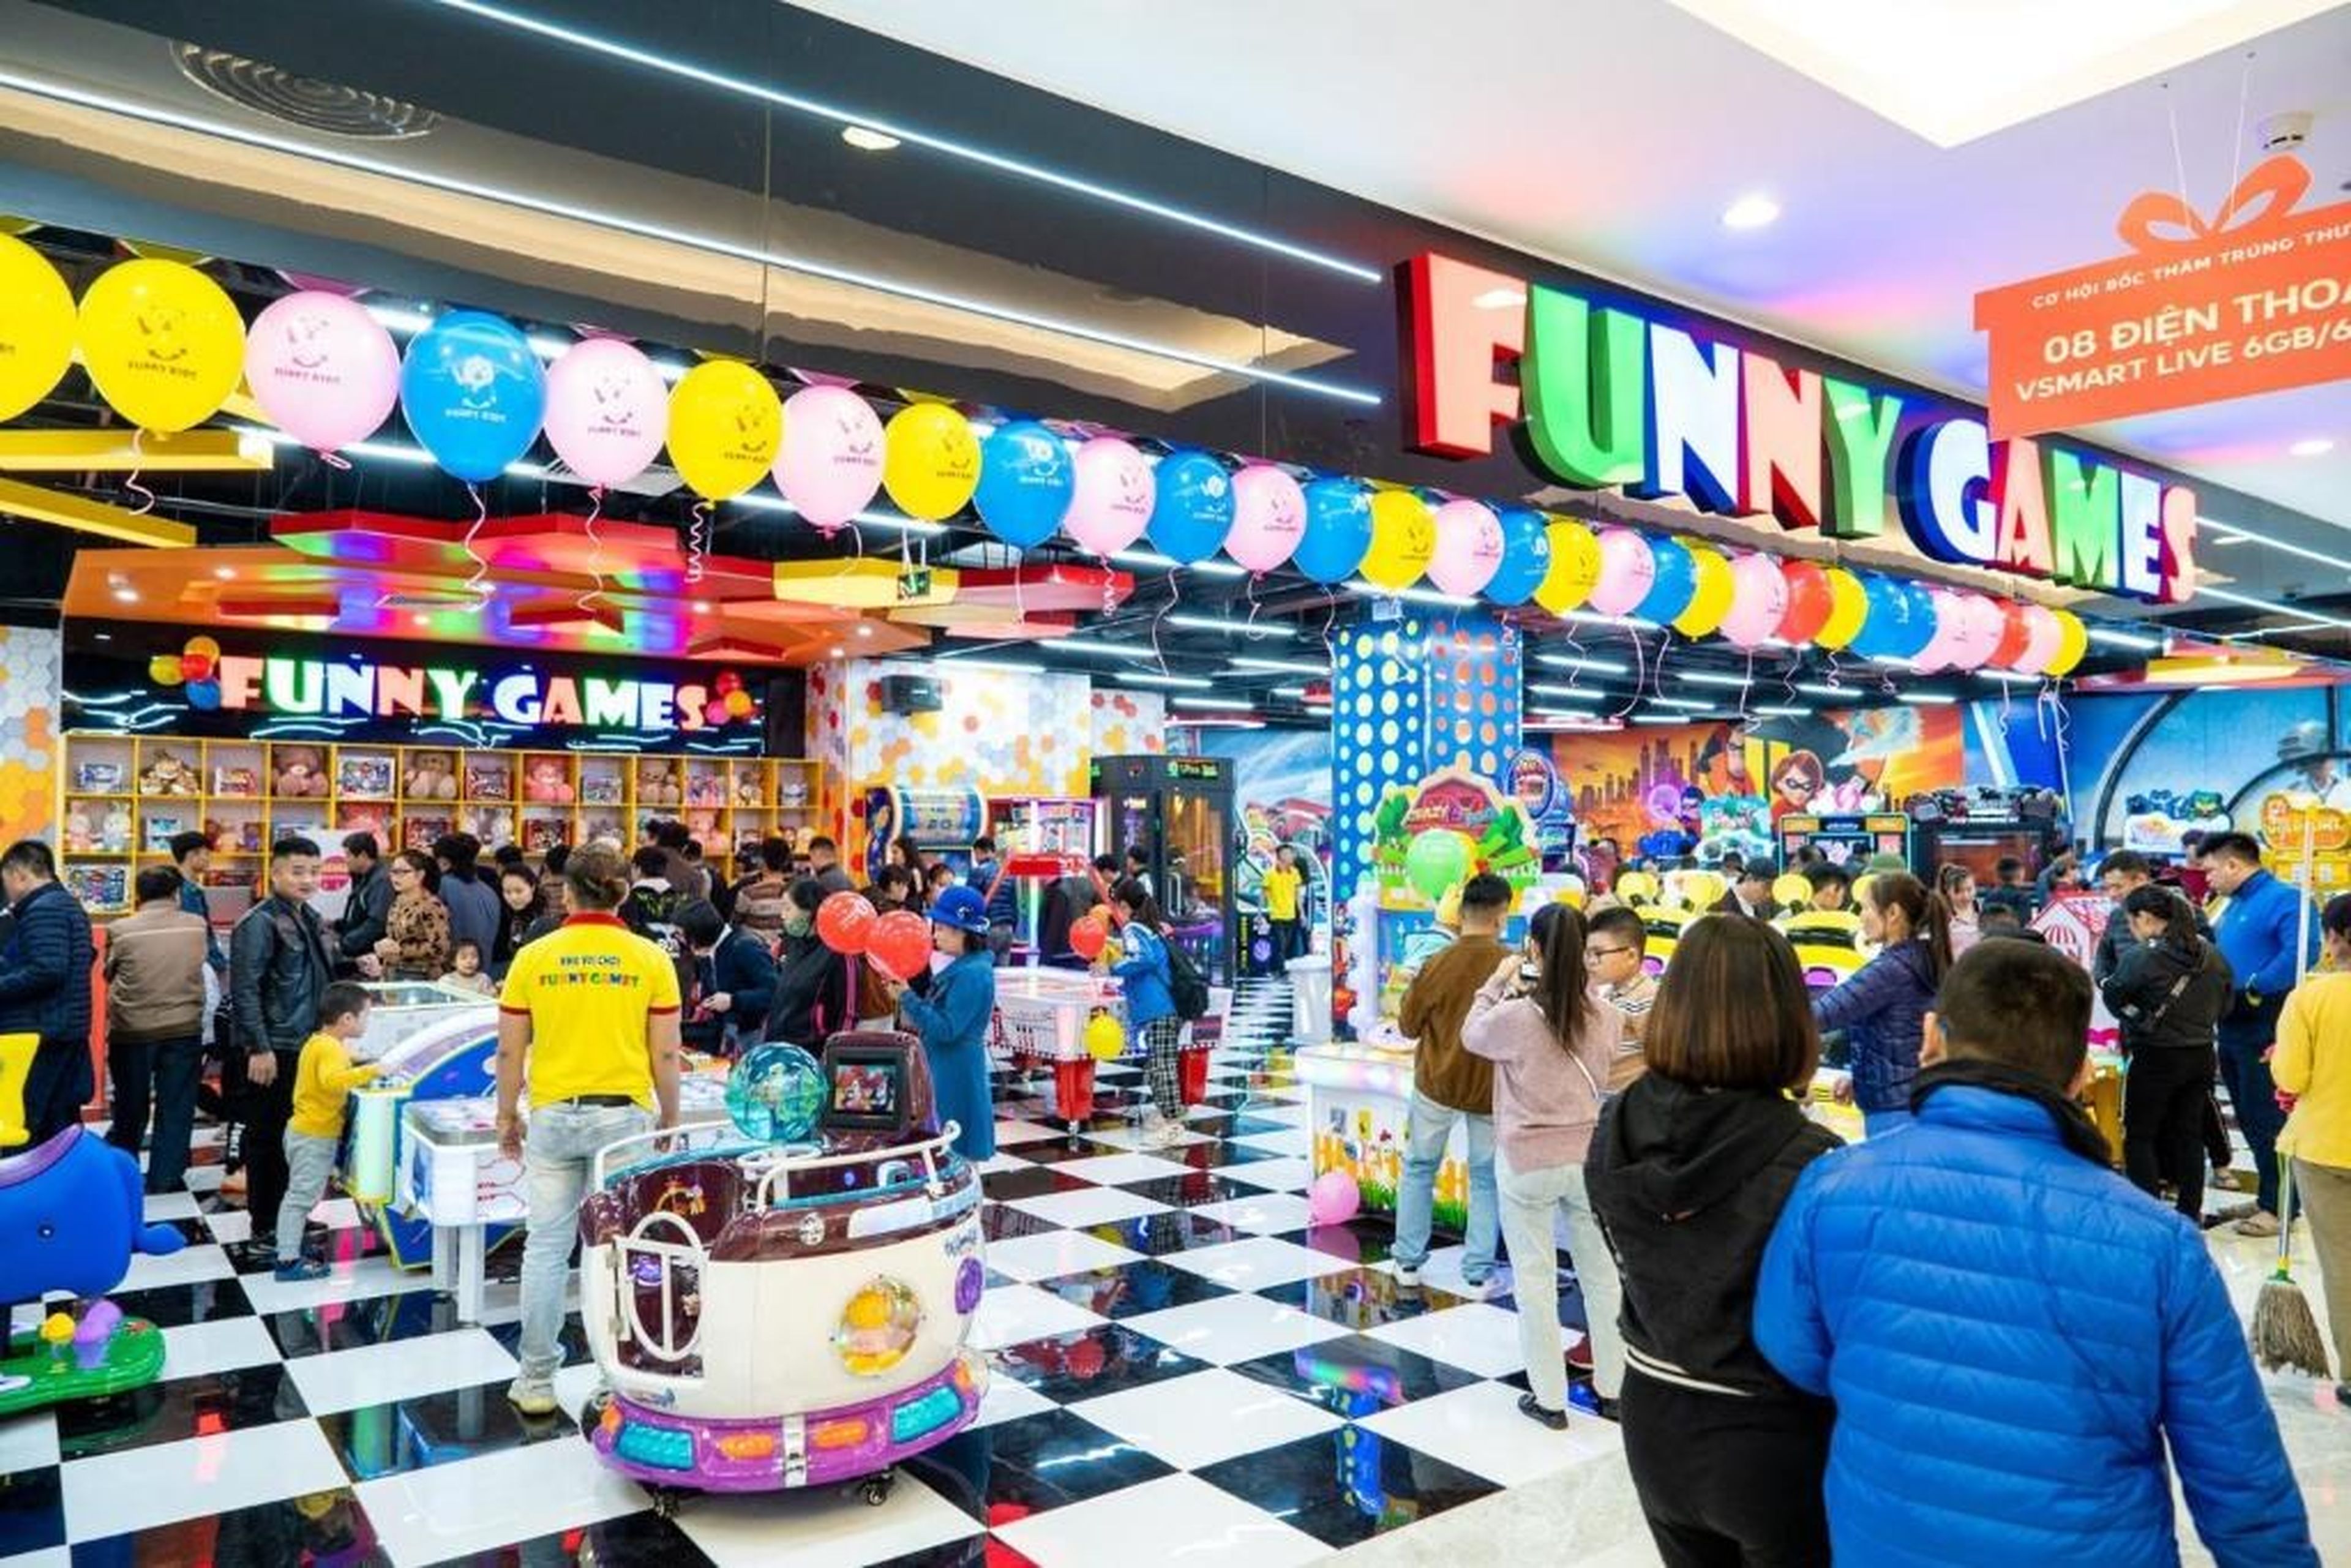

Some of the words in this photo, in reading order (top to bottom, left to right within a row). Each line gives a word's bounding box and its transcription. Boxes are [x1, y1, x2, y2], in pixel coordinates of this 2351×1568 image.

[2044, 329, 2096, 364] 08
[2110, 304, 2219, 350] ĐIỆN
[2015, 358, 2147, 402] VSMART
[2156, 342, 2232, 377] LIVE
[1402, 251, 1902, 541] FUNNY
[1897, 418, 2198, 604] GAMES
[220, 657, 476, 721] FUNNY
[492, 673, 708, 730] GAMES
